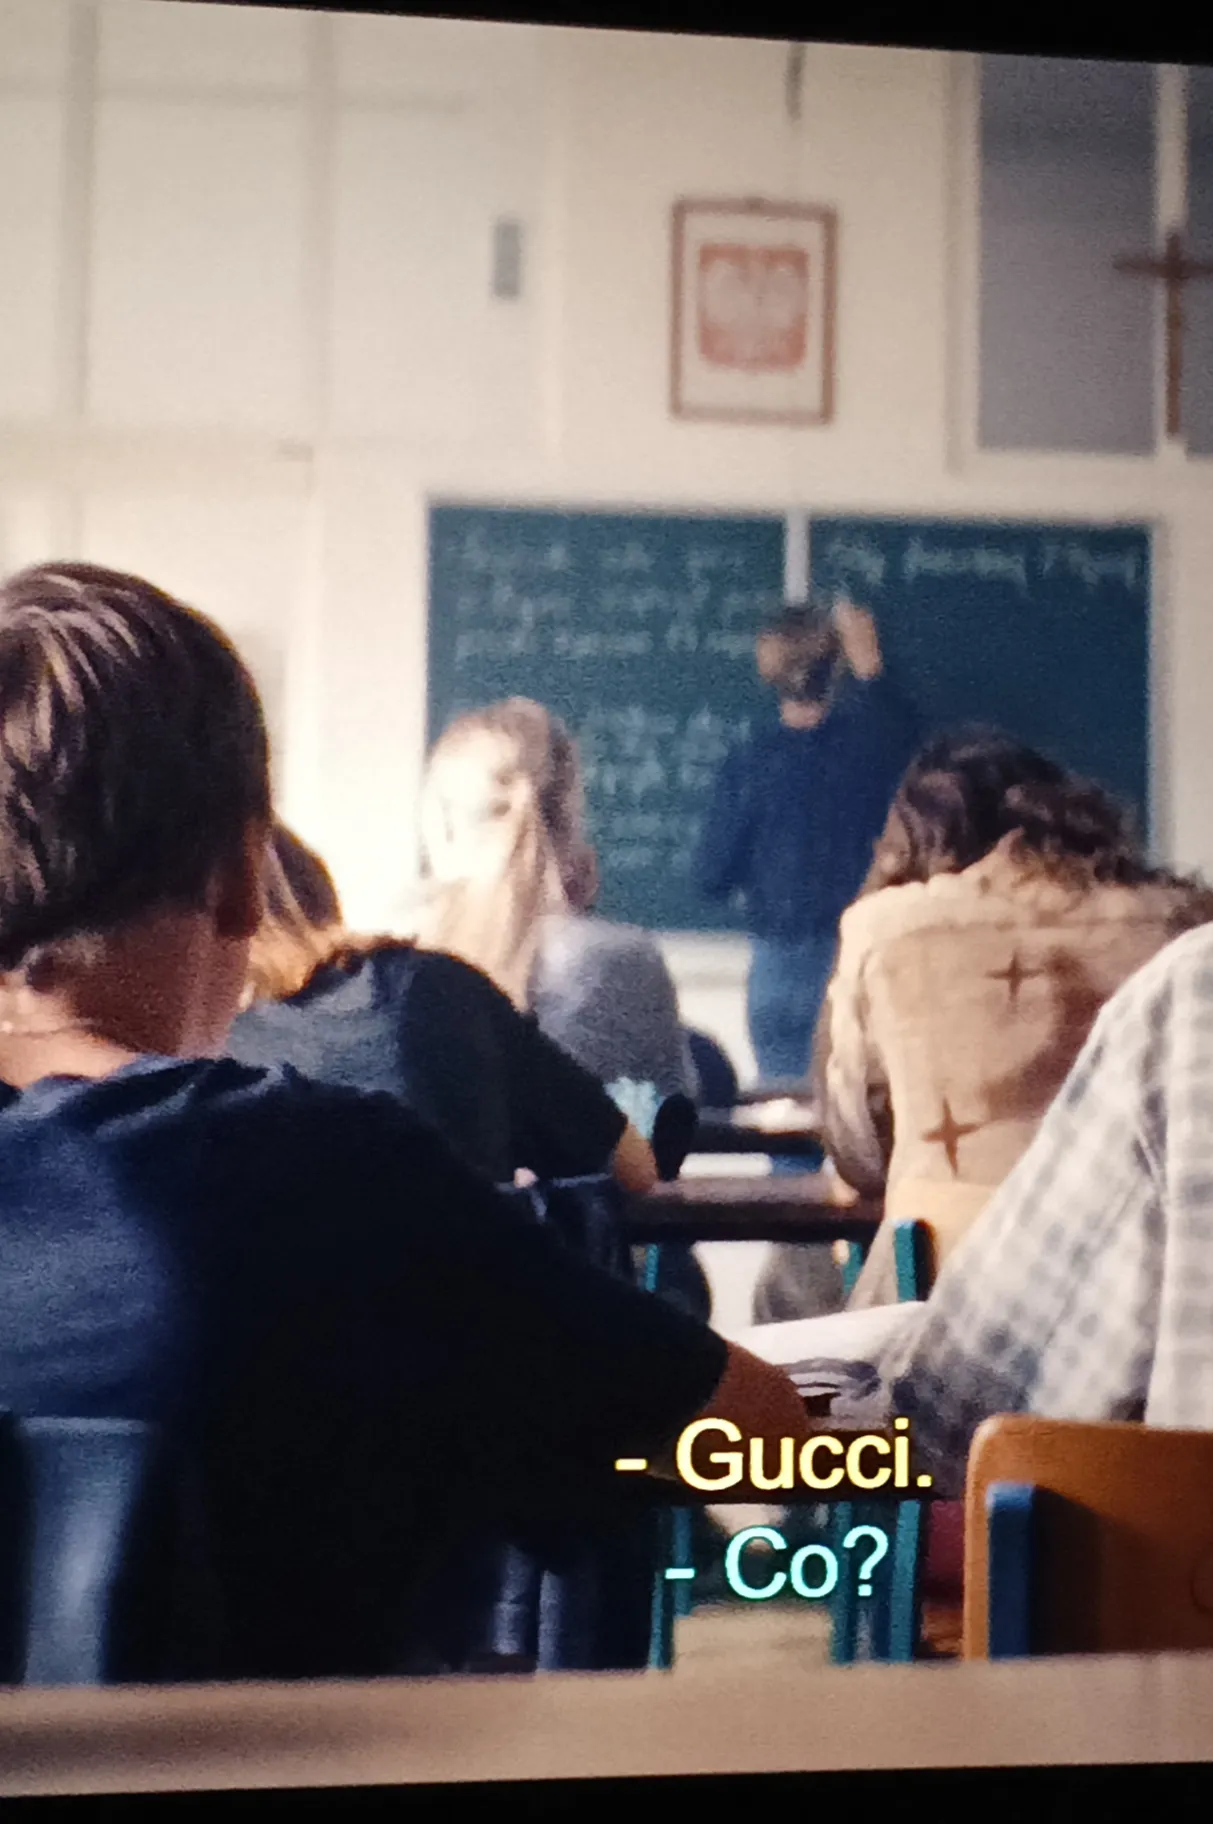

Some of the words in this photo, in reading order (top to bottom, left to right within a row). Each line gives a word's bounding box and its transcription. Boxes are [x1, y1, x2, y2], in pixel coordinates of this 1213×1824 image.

[615, 1458, 648, 1471] -
[676, 1417, 933, 1491] Gucci.
[665, 1567, 696, 1579] -
[725, 1525, 889, 1599] Co?
